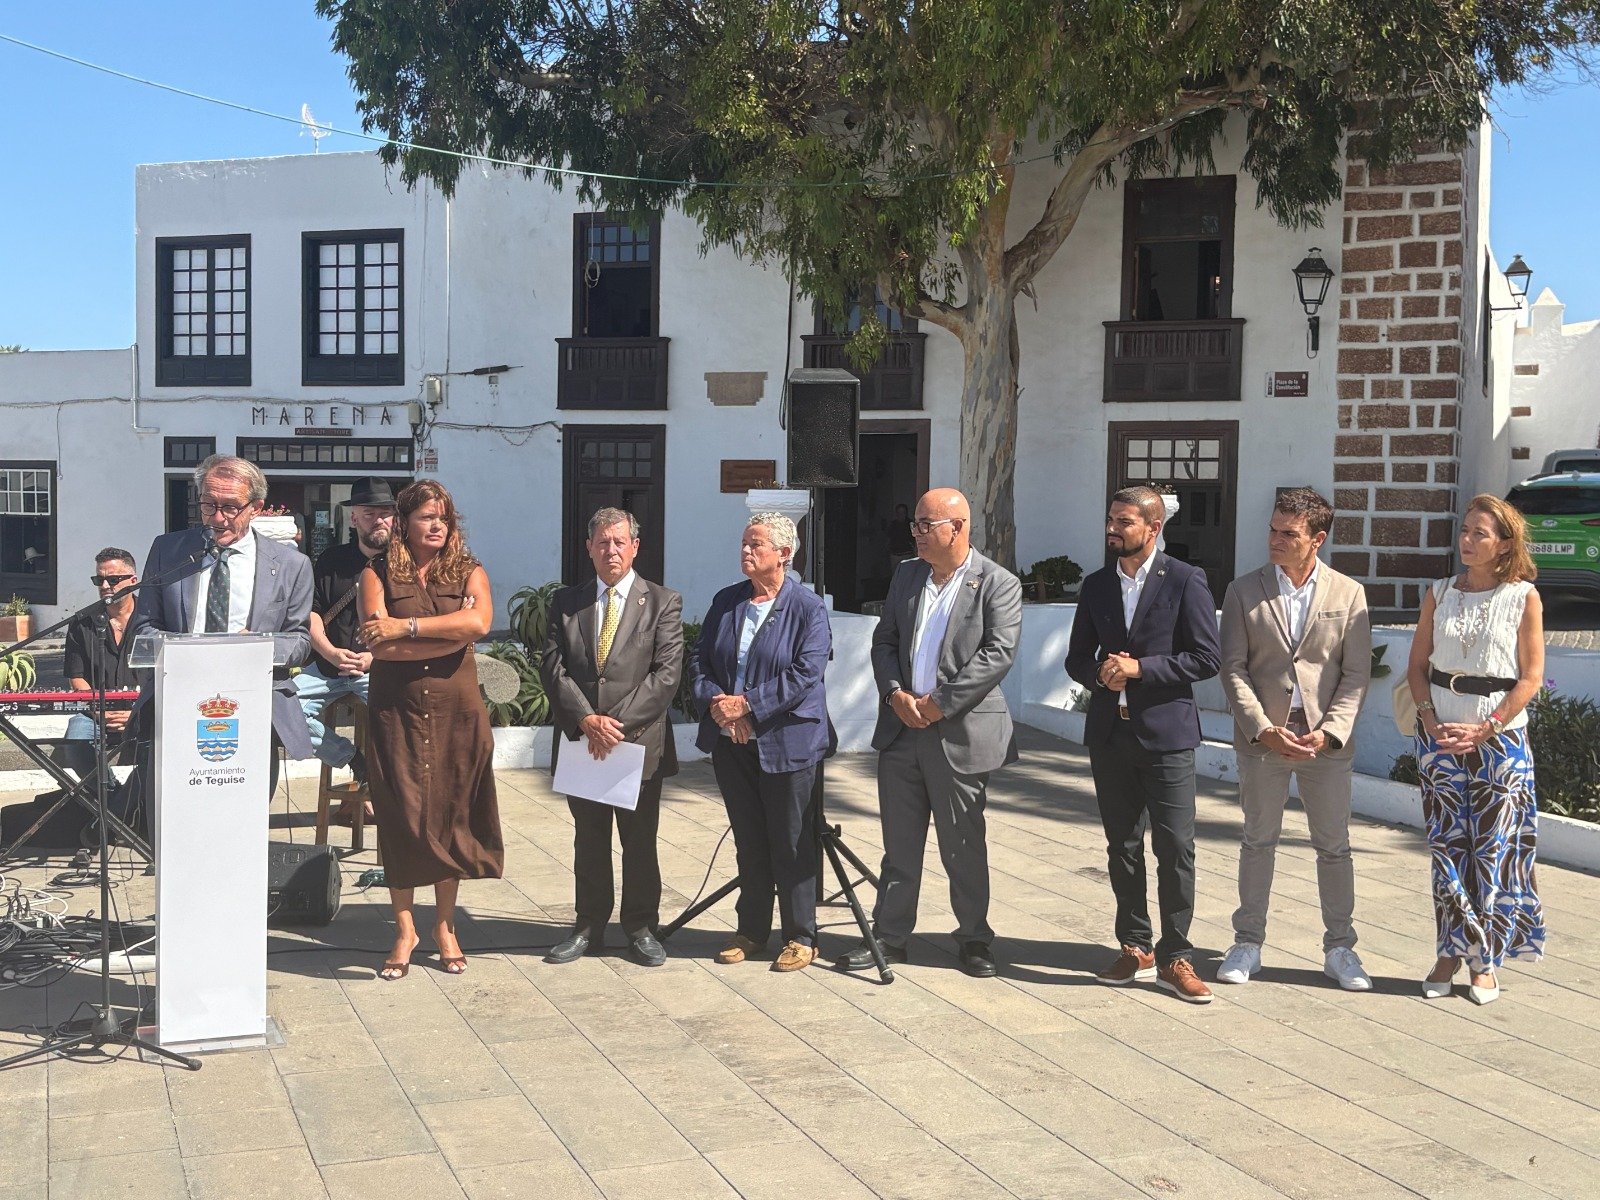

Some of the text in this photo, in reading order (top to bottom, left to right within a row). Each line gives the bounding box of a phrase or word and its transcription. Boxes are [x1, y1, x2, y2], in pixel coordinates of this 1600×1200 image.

[252, 406, 392, 425] MARENA
[1554, 544, 1572, 553] LMP
[189, 767, 246, 777] Ayuntamiento
[189, 776, 245, 786] de Teguise
